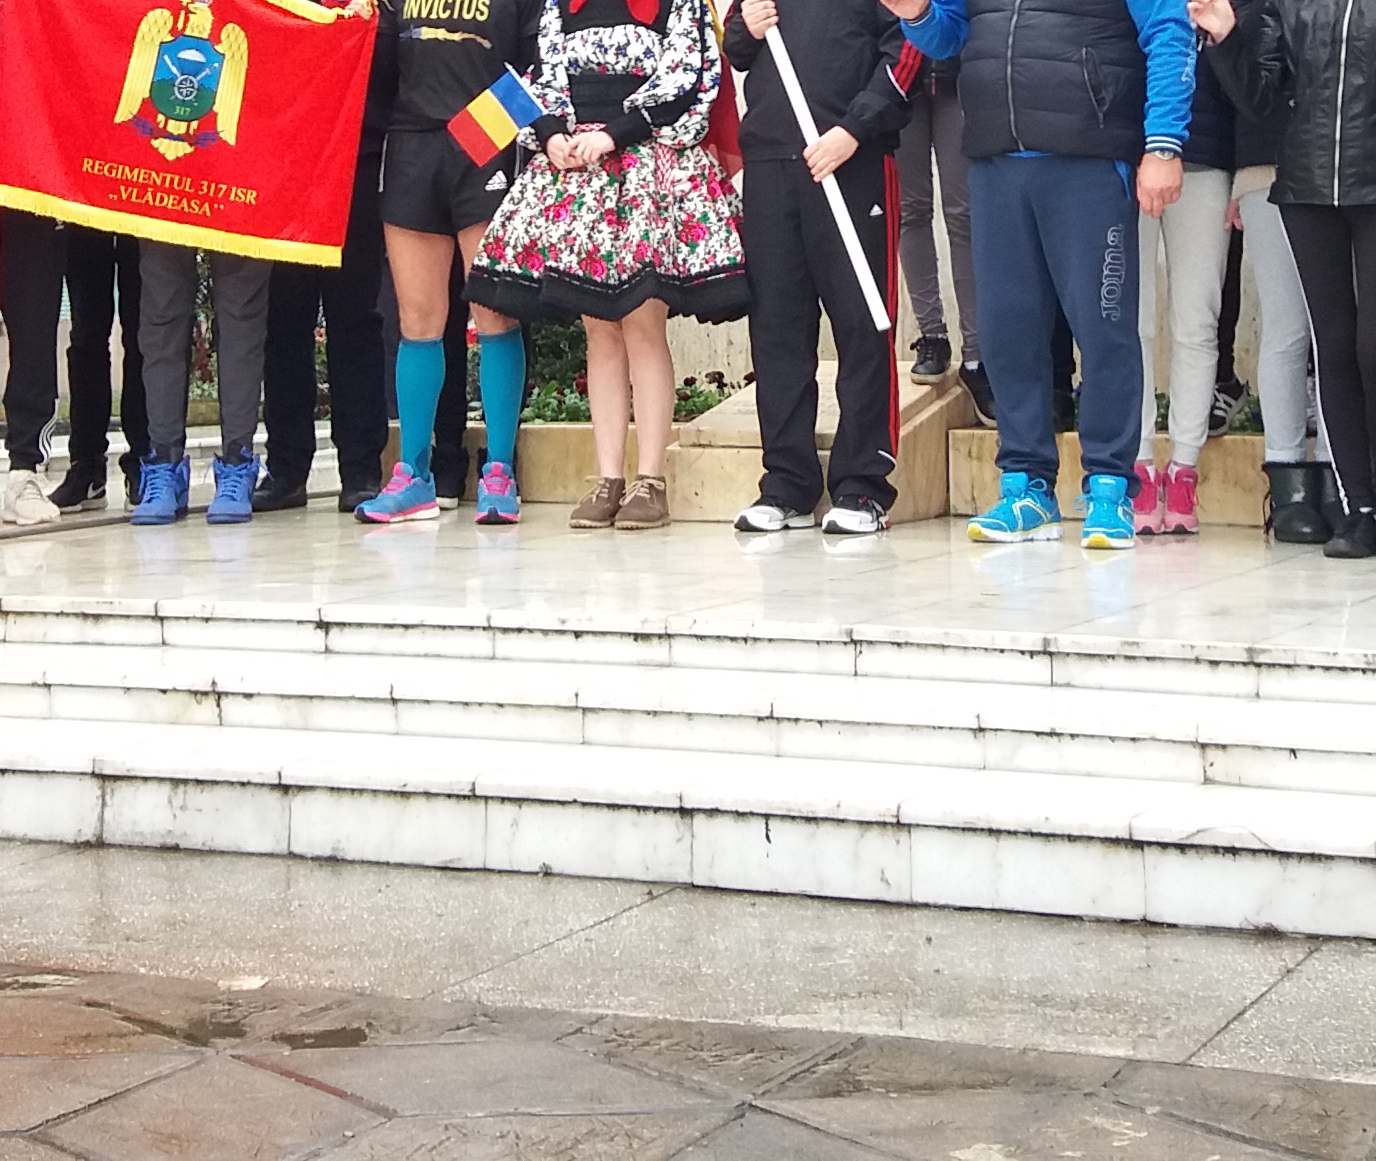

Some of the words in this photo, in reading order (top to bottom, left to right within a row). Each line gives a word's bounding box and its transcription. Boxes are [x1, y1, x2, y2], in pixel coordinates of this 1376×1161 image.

[82, 157, 195, 192] REGIMENTUL
[197, 180, 227, 199] 317
[229, 186, 257, 205] ISR
